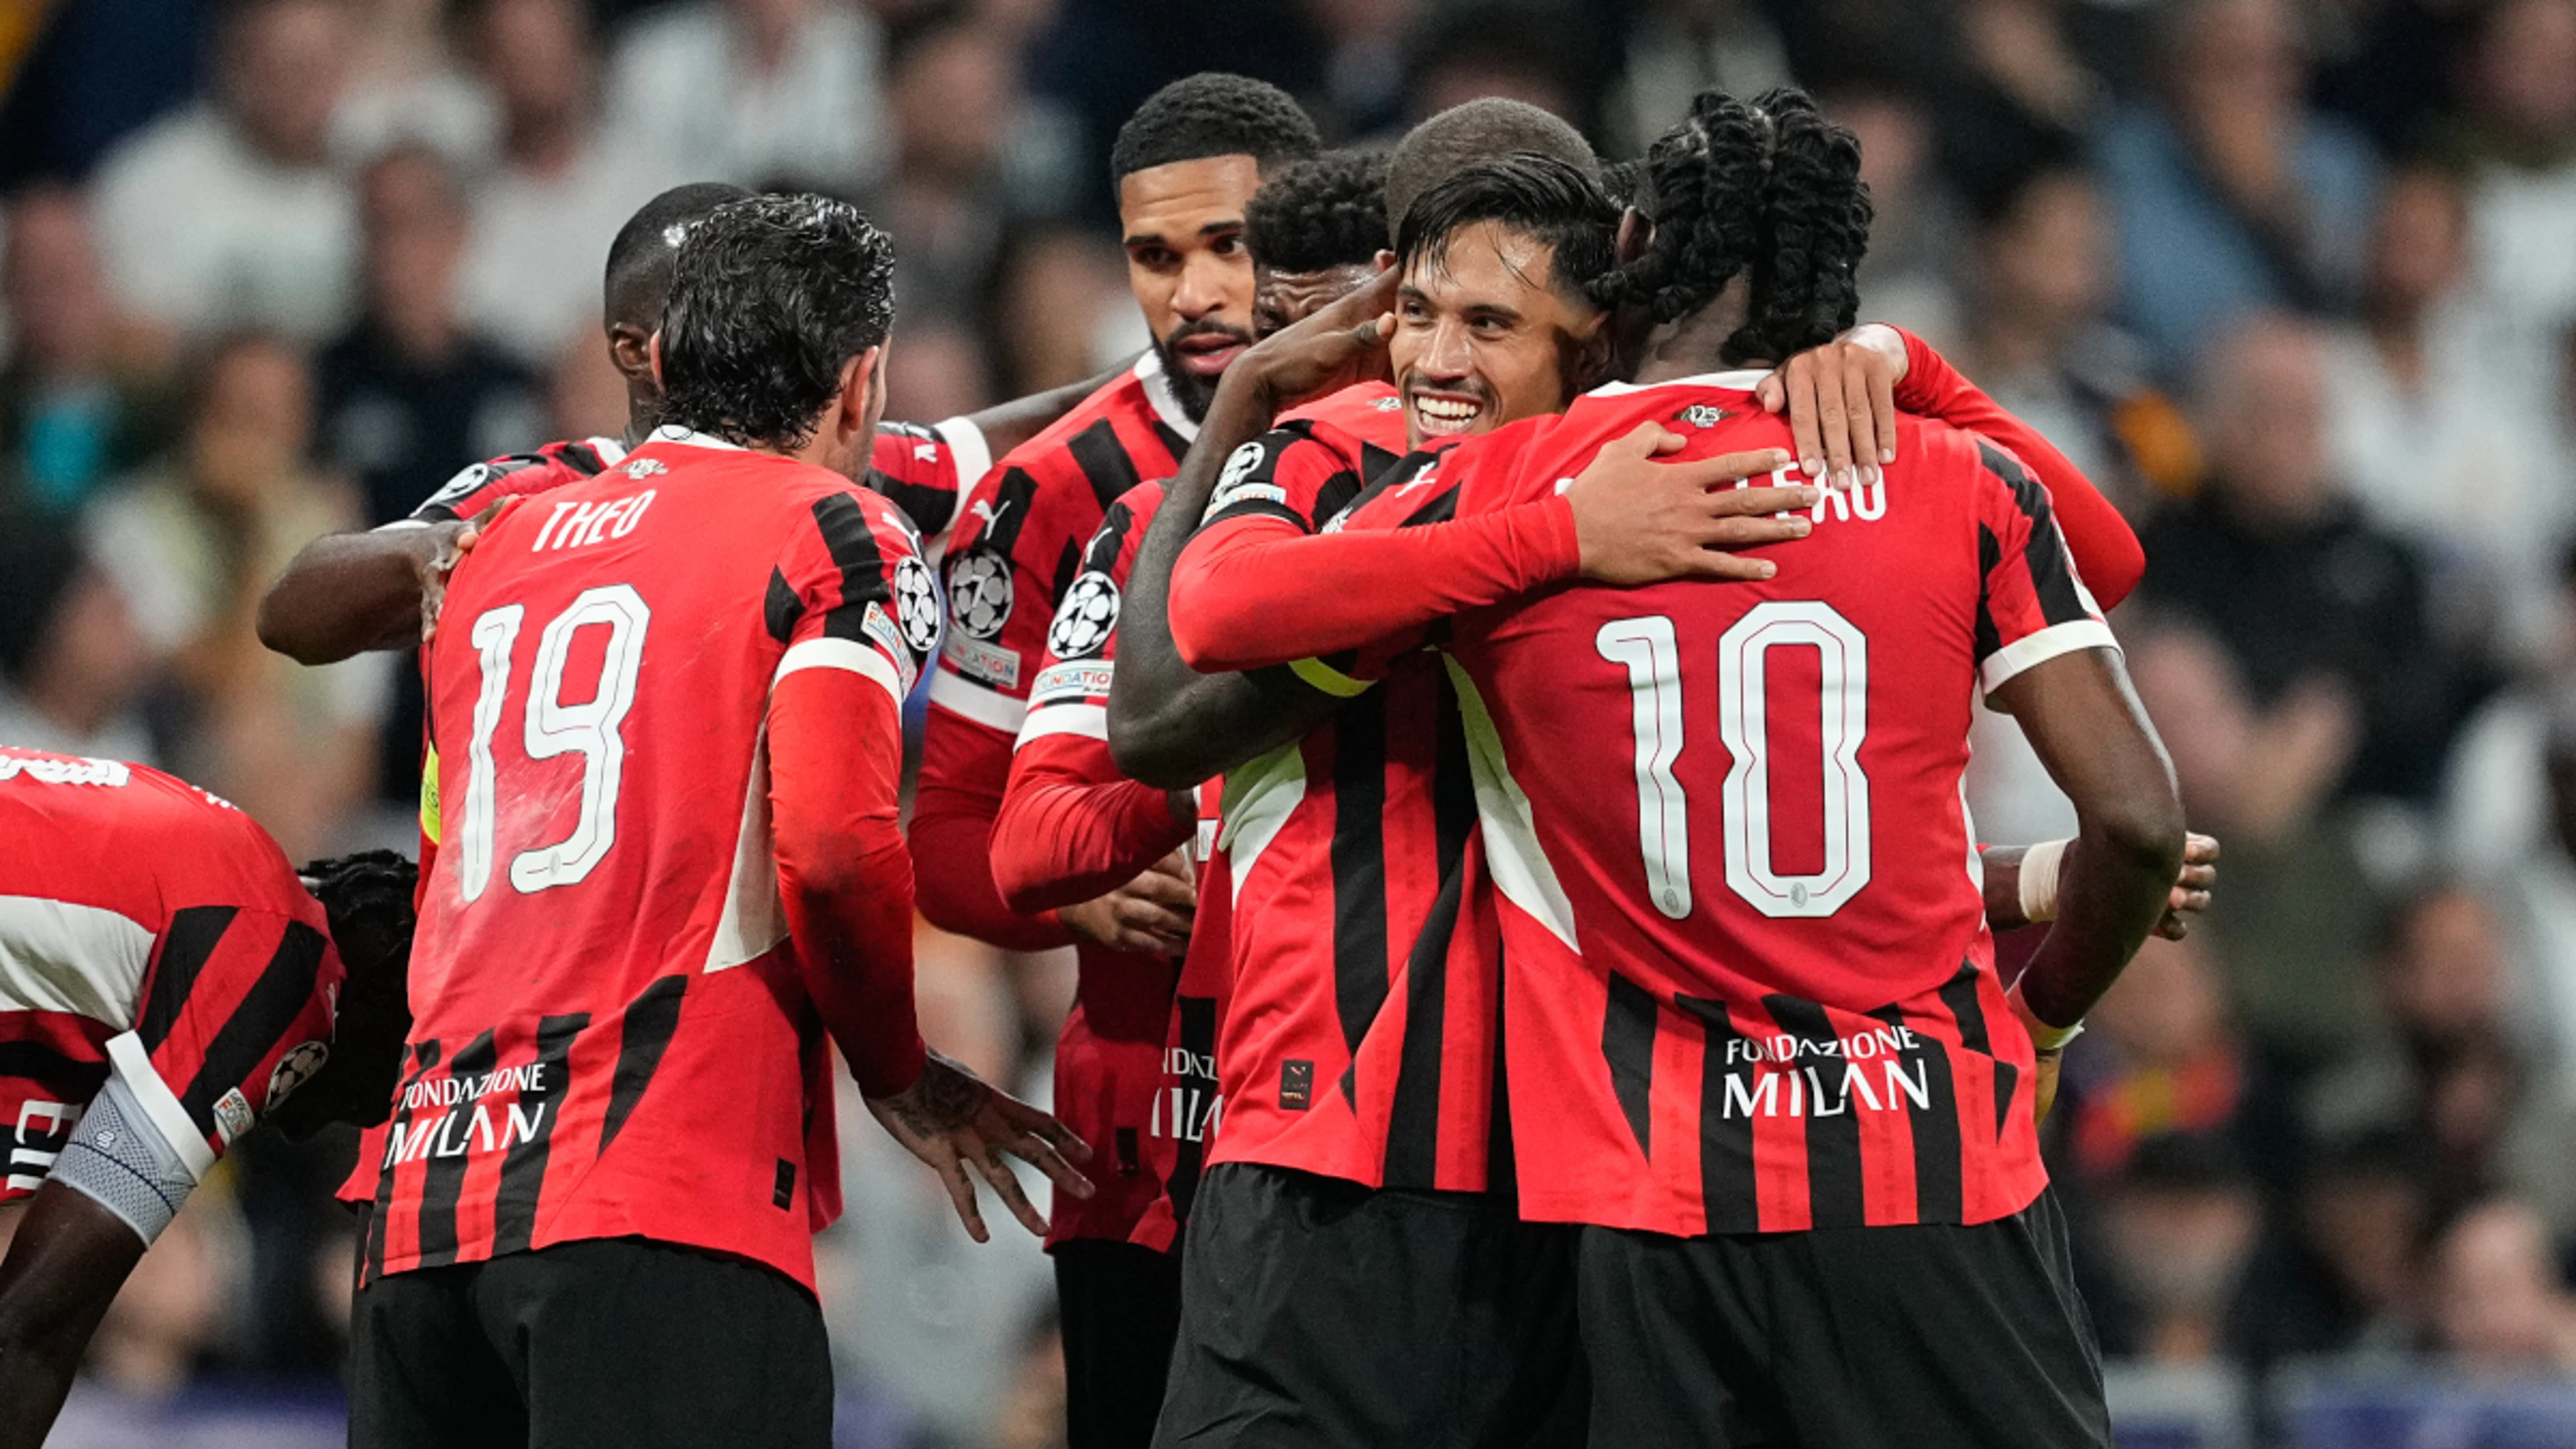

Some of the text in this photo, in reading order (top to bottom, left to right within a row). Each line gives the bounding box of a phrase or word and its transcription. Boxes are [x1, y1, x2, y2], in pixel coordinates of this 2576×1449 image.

[532, 489, 657, 552] THEO
[461, 583, 652, 904] 19
[1595, 600, 1872, 920] 10
[1723, 1058, 1931, 1119] MILAN
[383, 1102, 545, 1171] MILAN
